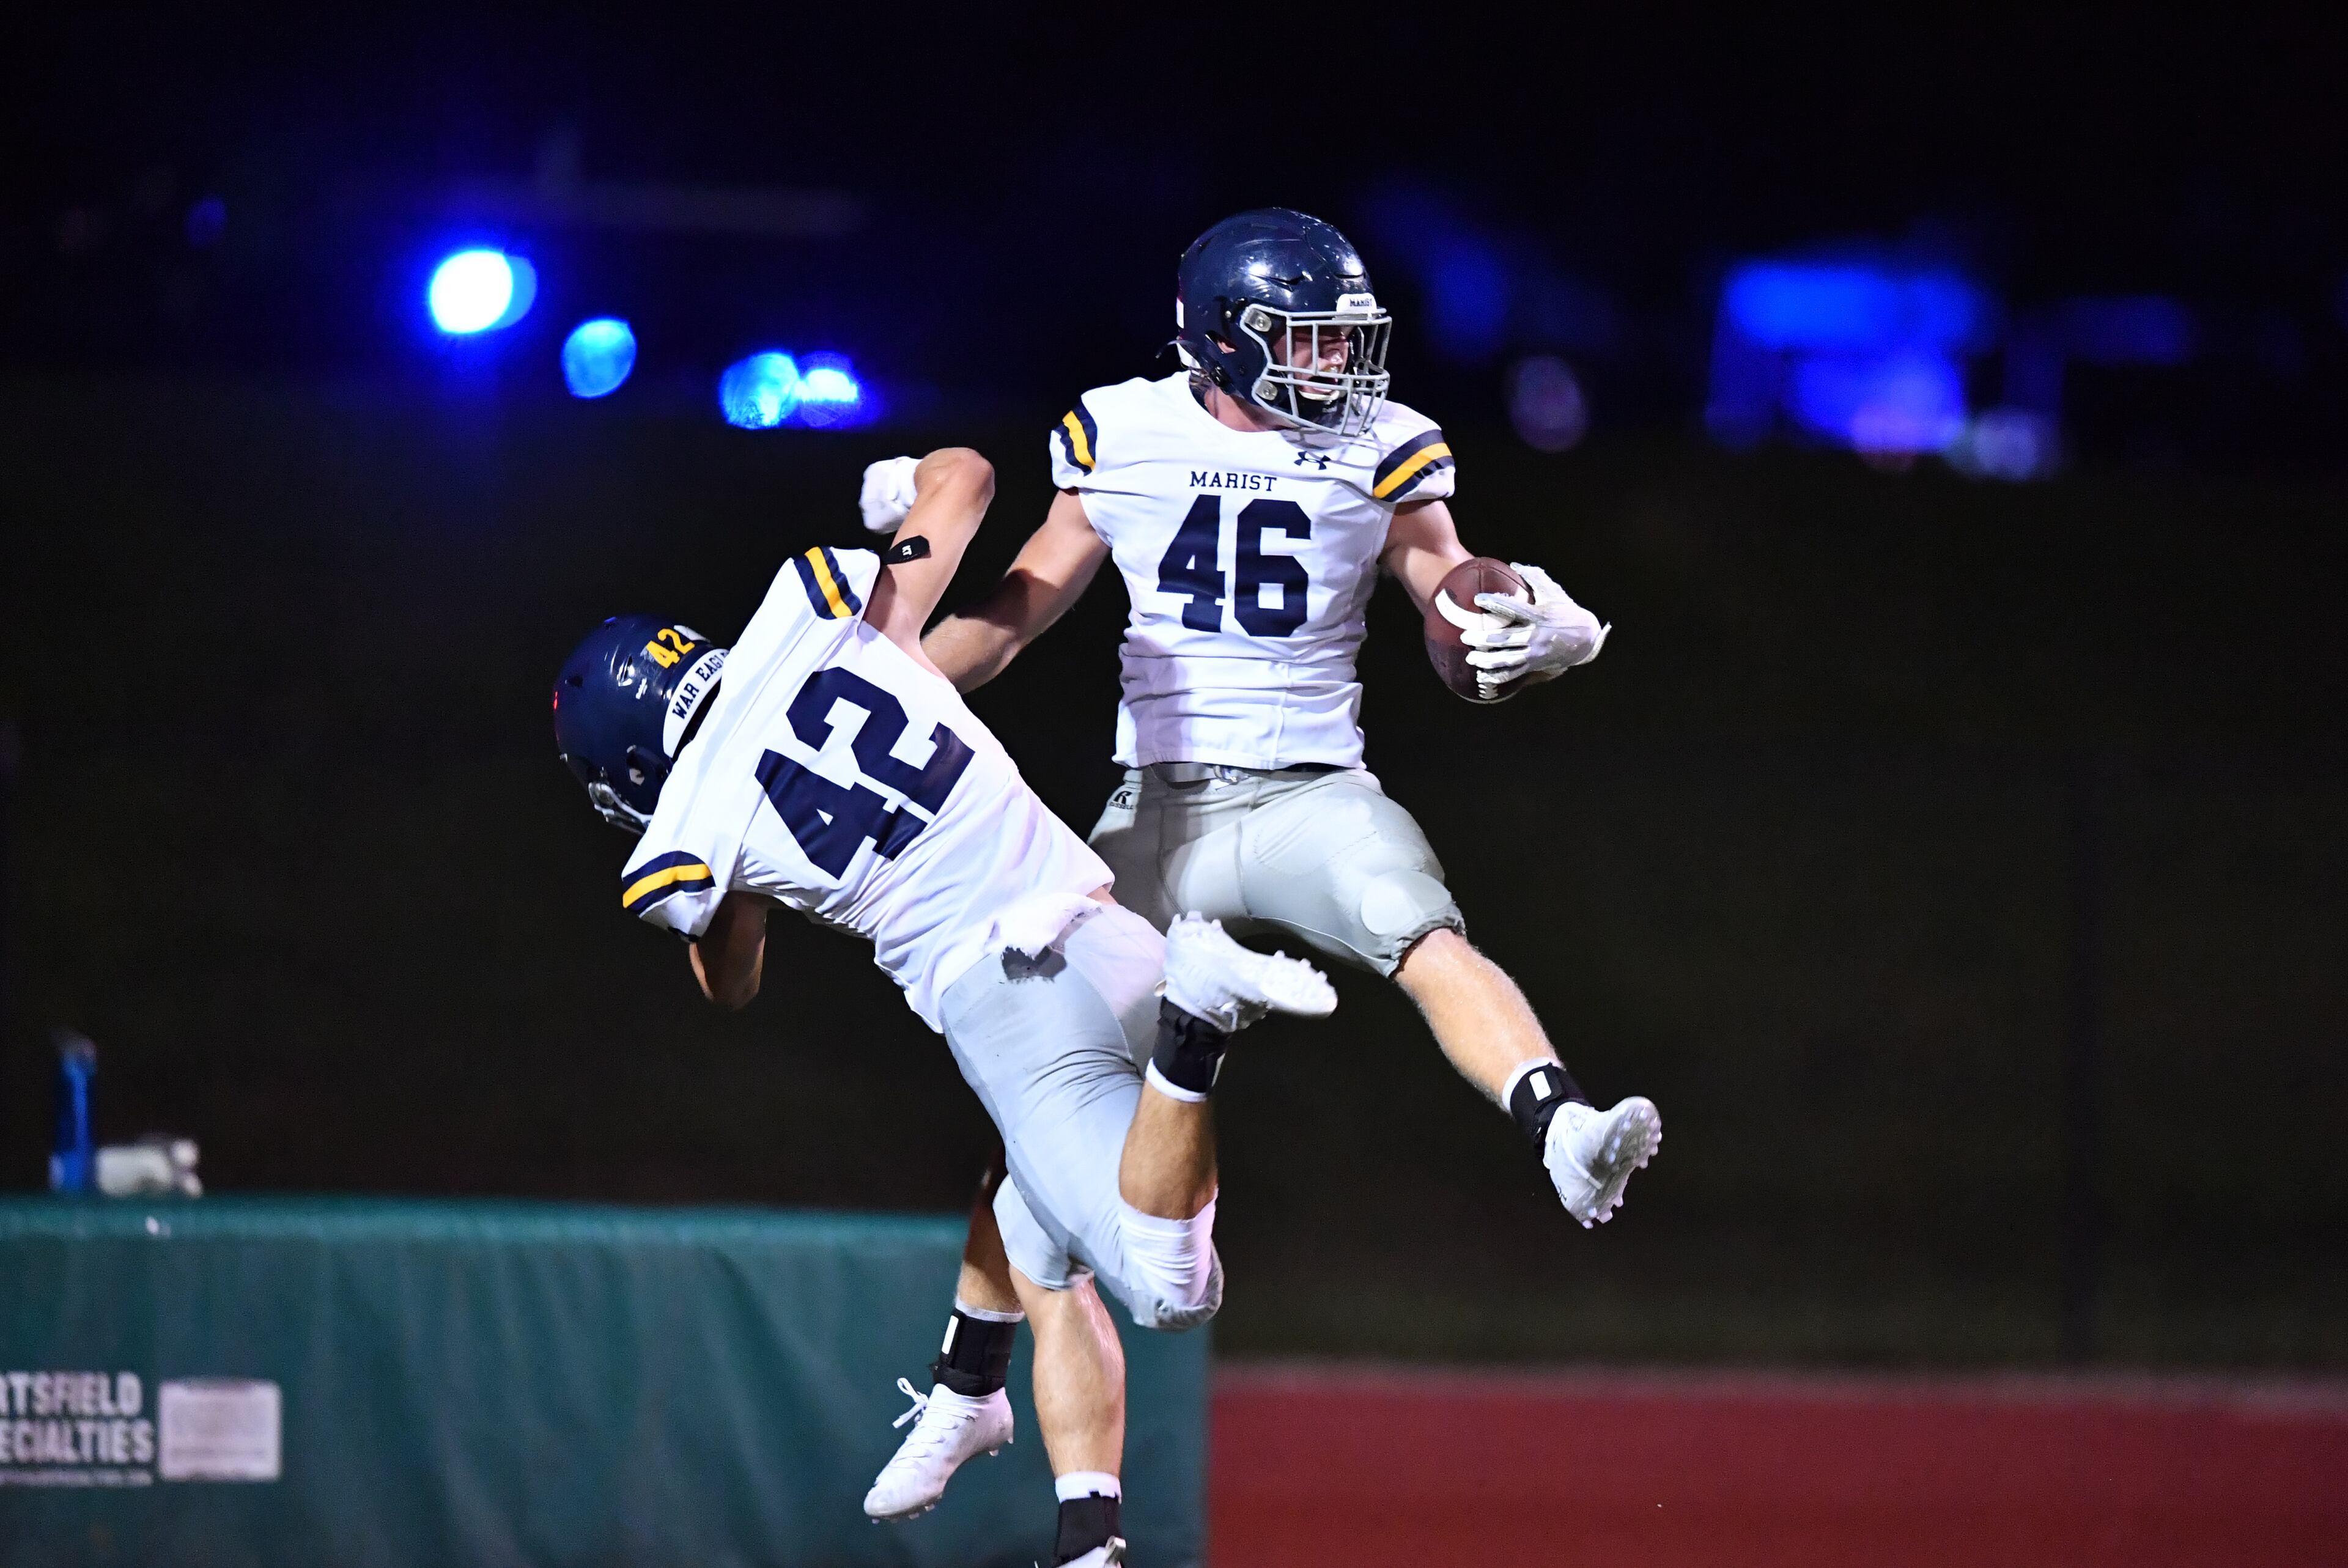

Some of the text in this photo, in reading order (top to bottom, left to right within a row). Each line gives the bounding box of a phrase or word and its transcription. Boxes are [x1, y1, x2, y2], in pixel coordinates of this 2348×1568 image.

[1189, 471, 1277, 491] MARIST
[1156, 494, 1311, 638] 46
[646, 628, 695, 669] 42
[672, 682, 700, 720] WAR
[755, 666, 976, 881] 42
